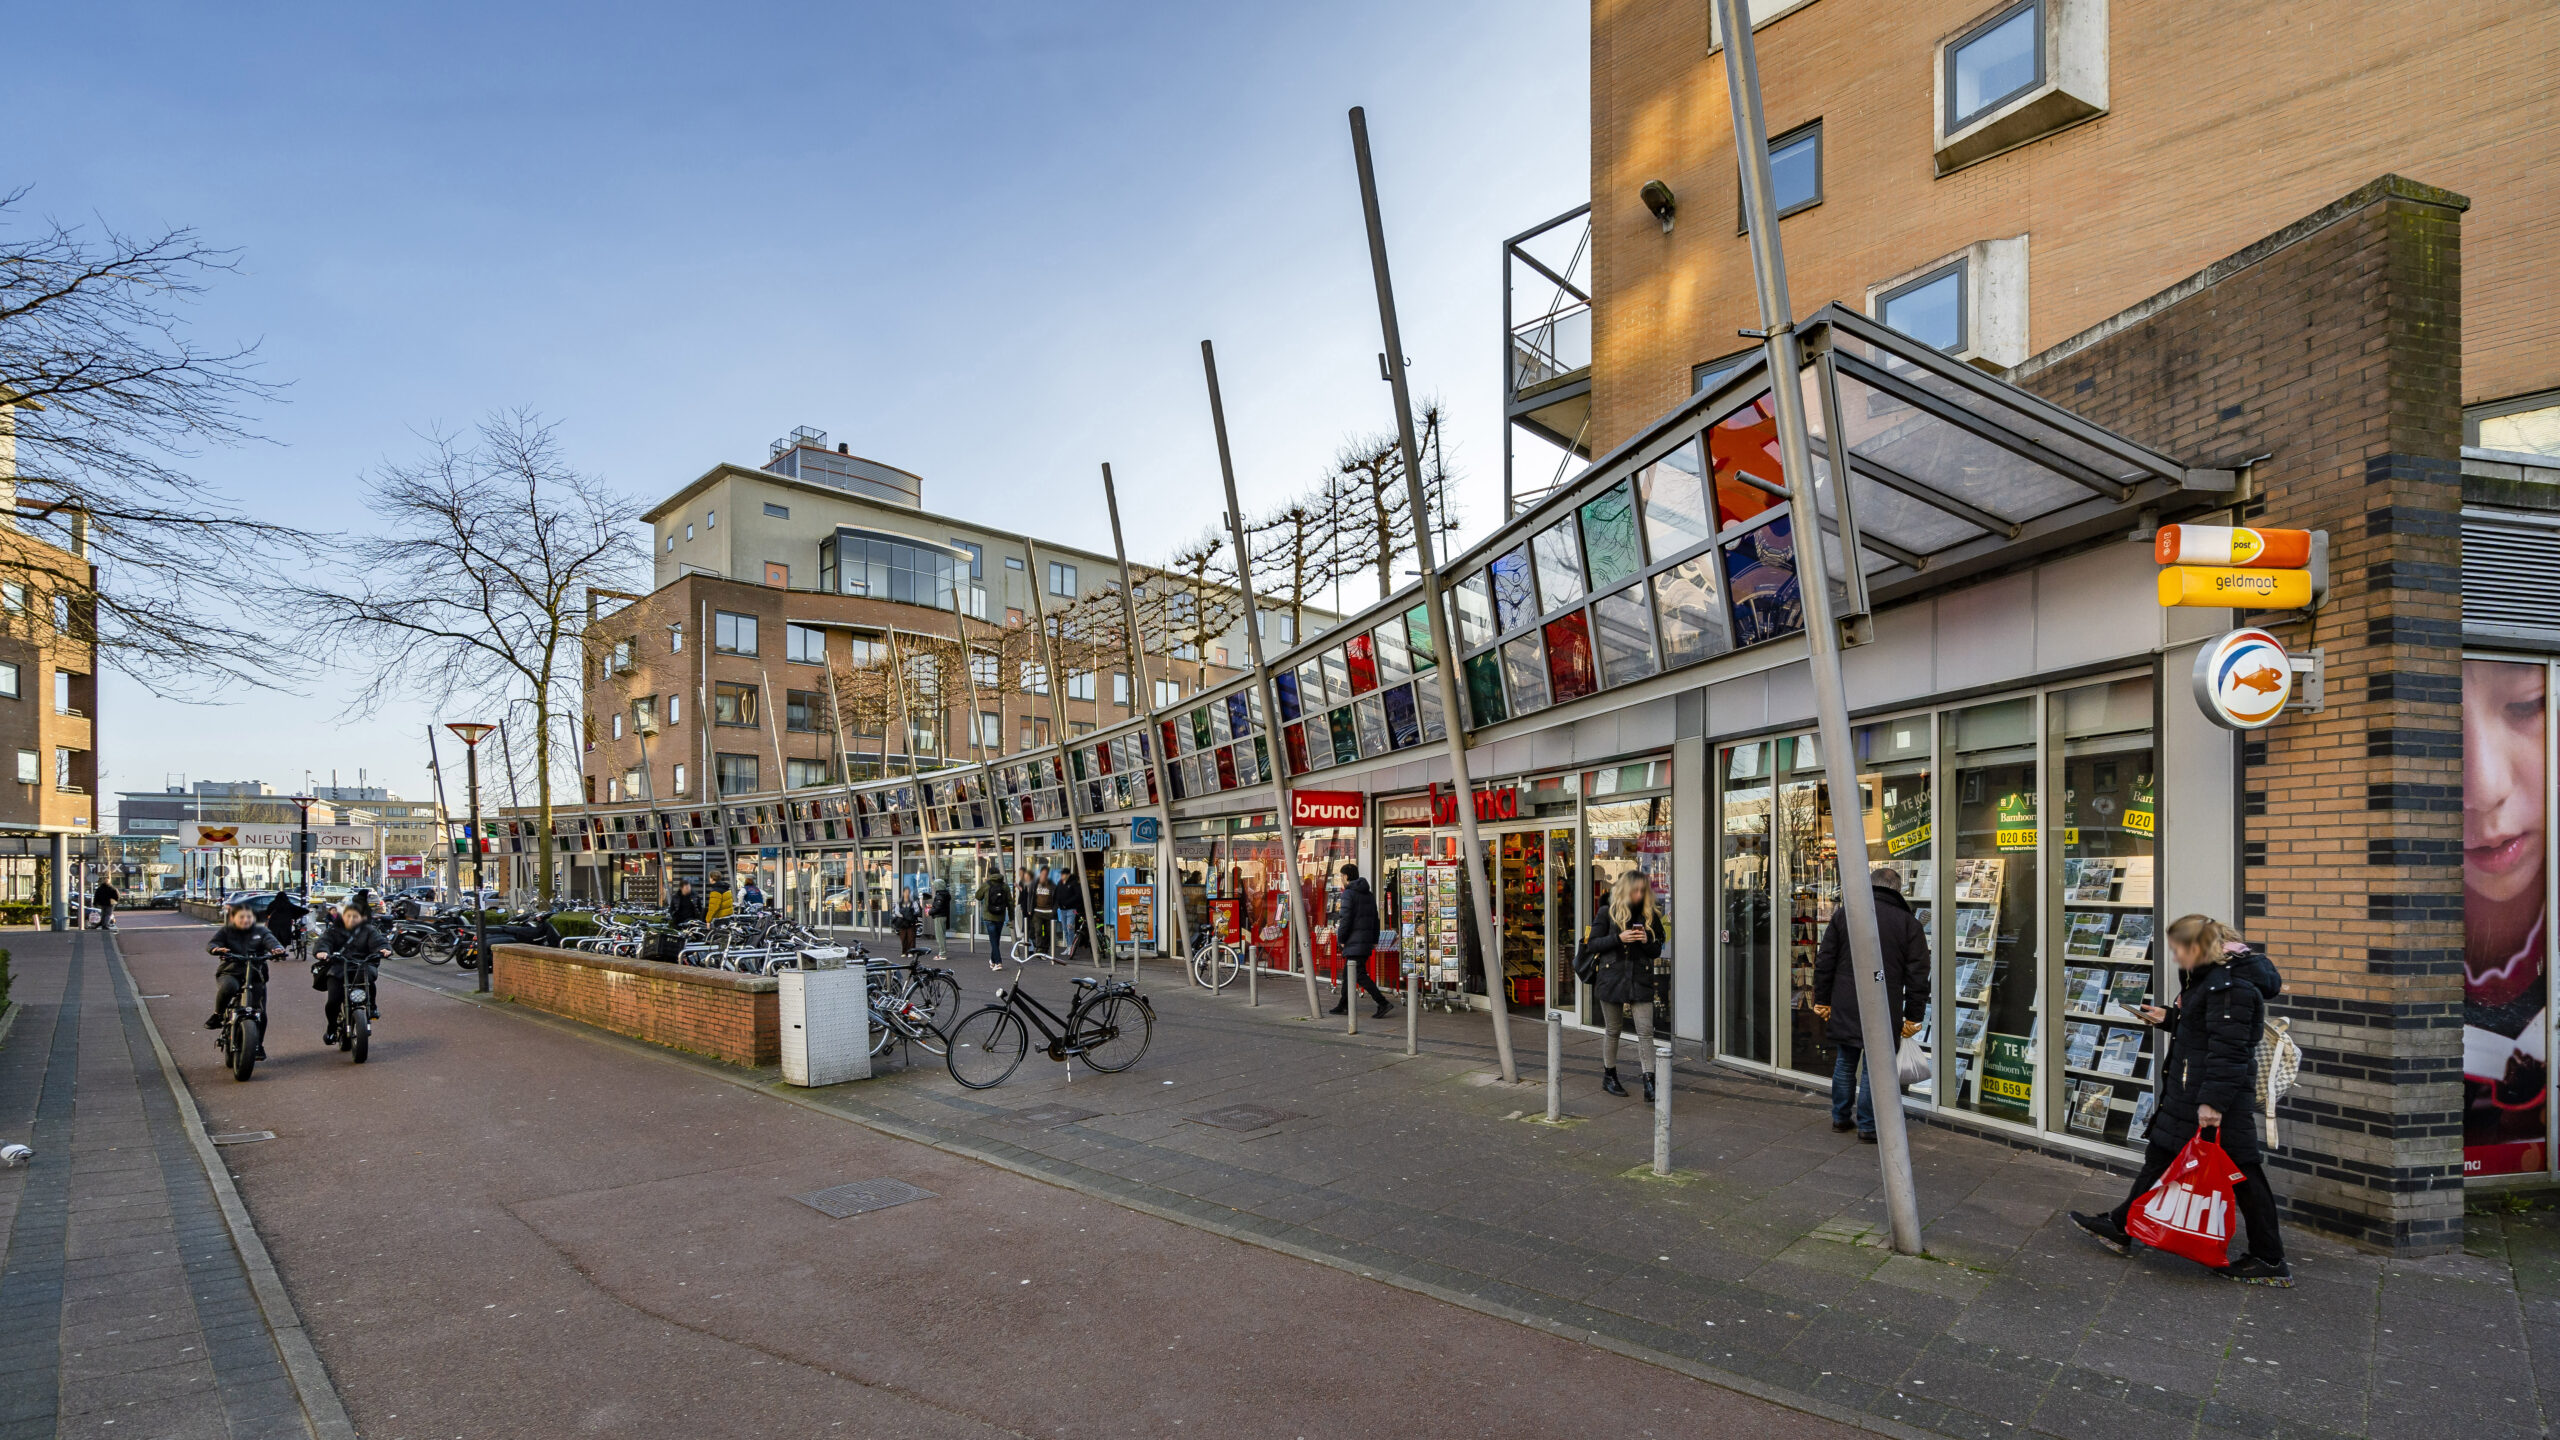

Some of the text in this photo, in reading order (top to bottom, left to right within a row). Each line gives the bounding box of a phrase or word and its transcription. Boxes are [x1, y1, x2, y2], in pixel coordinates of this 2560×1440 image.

[2234, 541, 2258, 550] postnl
[2216, 574, 2278, 590] geldmaat
[1296, 797, 1359, 819] bruna
[1429, 782, 1517, 825] brna
[1901, 798, 1914, 811] TE
[2128, 813, 2151, 828] 020
[316, 835, 361, 846] LOTEN
[1082, 828, 1110, 852] Heijn
[1907, 830, 1922, 844] 659
[2000, 832, 2018, 844] 020
[2065, 830, 2073, 842] 4
[2004, 1043, 2018, 1057] TE
[1984, 1078, 2000, 1091] 020
[2003, 1082, 2021, 1096] 659
[2143, 1180, 2227, 1237] Dirk
